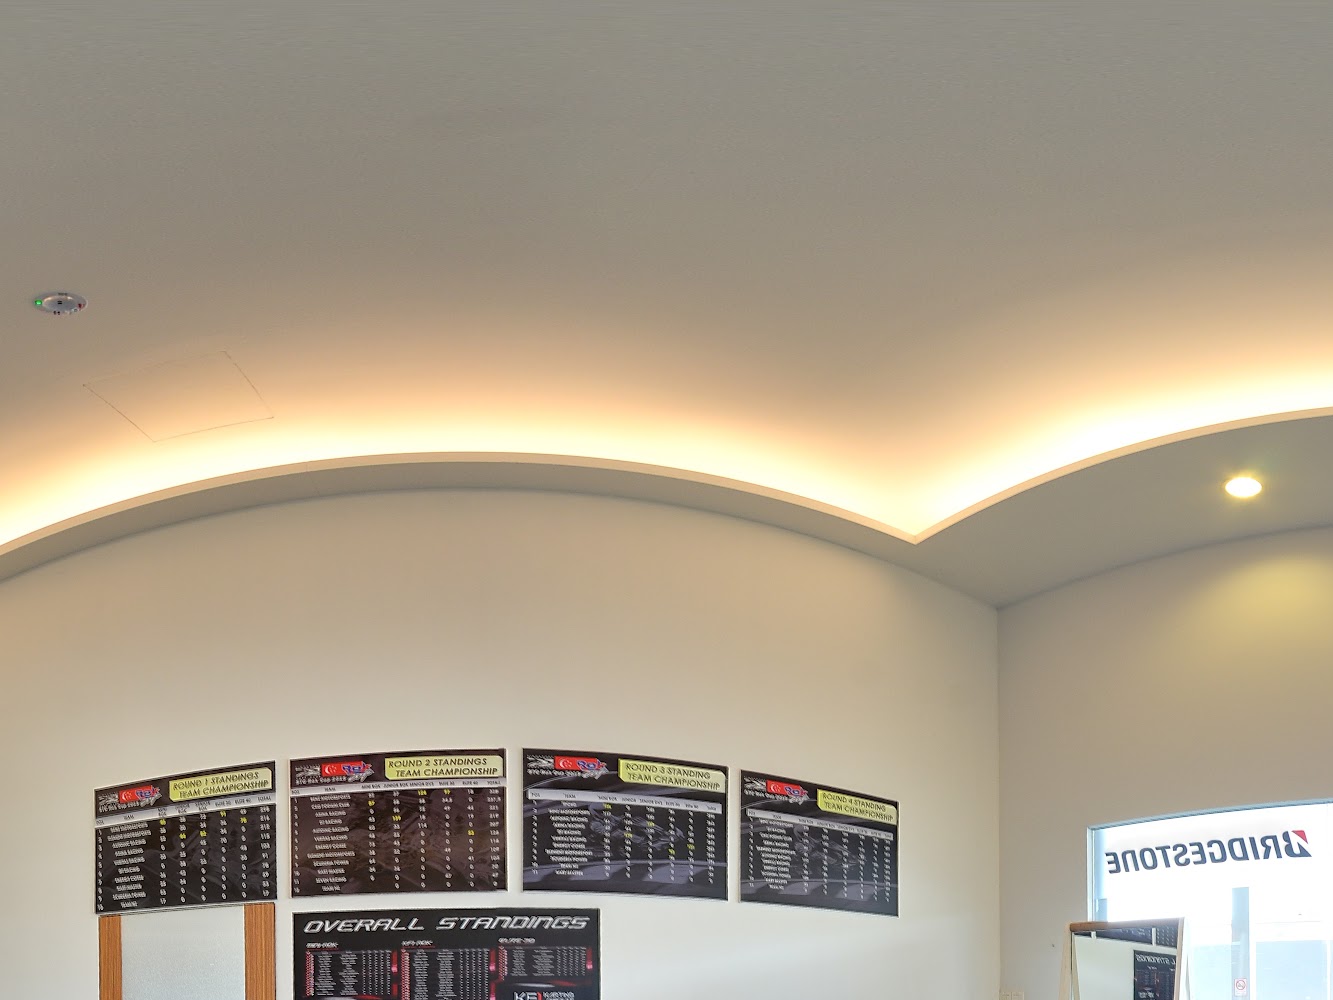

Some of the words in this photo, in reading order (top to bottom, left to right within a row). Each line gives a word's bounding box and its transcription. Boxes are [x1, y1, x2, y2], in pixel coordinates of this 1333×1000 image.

[388, 759, 422, 768] ROUND
[432, 757, 487, 766] STANDINGS
[626, 763, 658, 774] ROUND
[660, 766, 666, 774] 3
[667, 766, 711, 779] STANDING
[173, 779, 202, 790] ROUND
[204, 777, 208, 787] 1
[210, 771, 259, 785] STANDINGS
[395, 768, 421, 777] TEAM
[423, 767, 498, 777] CHAMPIONSHIP
[179, 788, 201, 798] TEAM
[202, 780, 269, 796] CHAMPIONSHIP
[628, 772, 653, 782] TEAM
[654, 775, 720, 791] CHAMPIONSHIP
[822, 792, 847, 803] ROUND
[853, 799, 886, 812] STANDING
[824, 801, 843, 811] TEAM
[844, 805, 894, 822] CHAMPIONSHIP
[303, 917, 425, 933] OVERALL
[436, 915, 590, 931] STANDINGS
